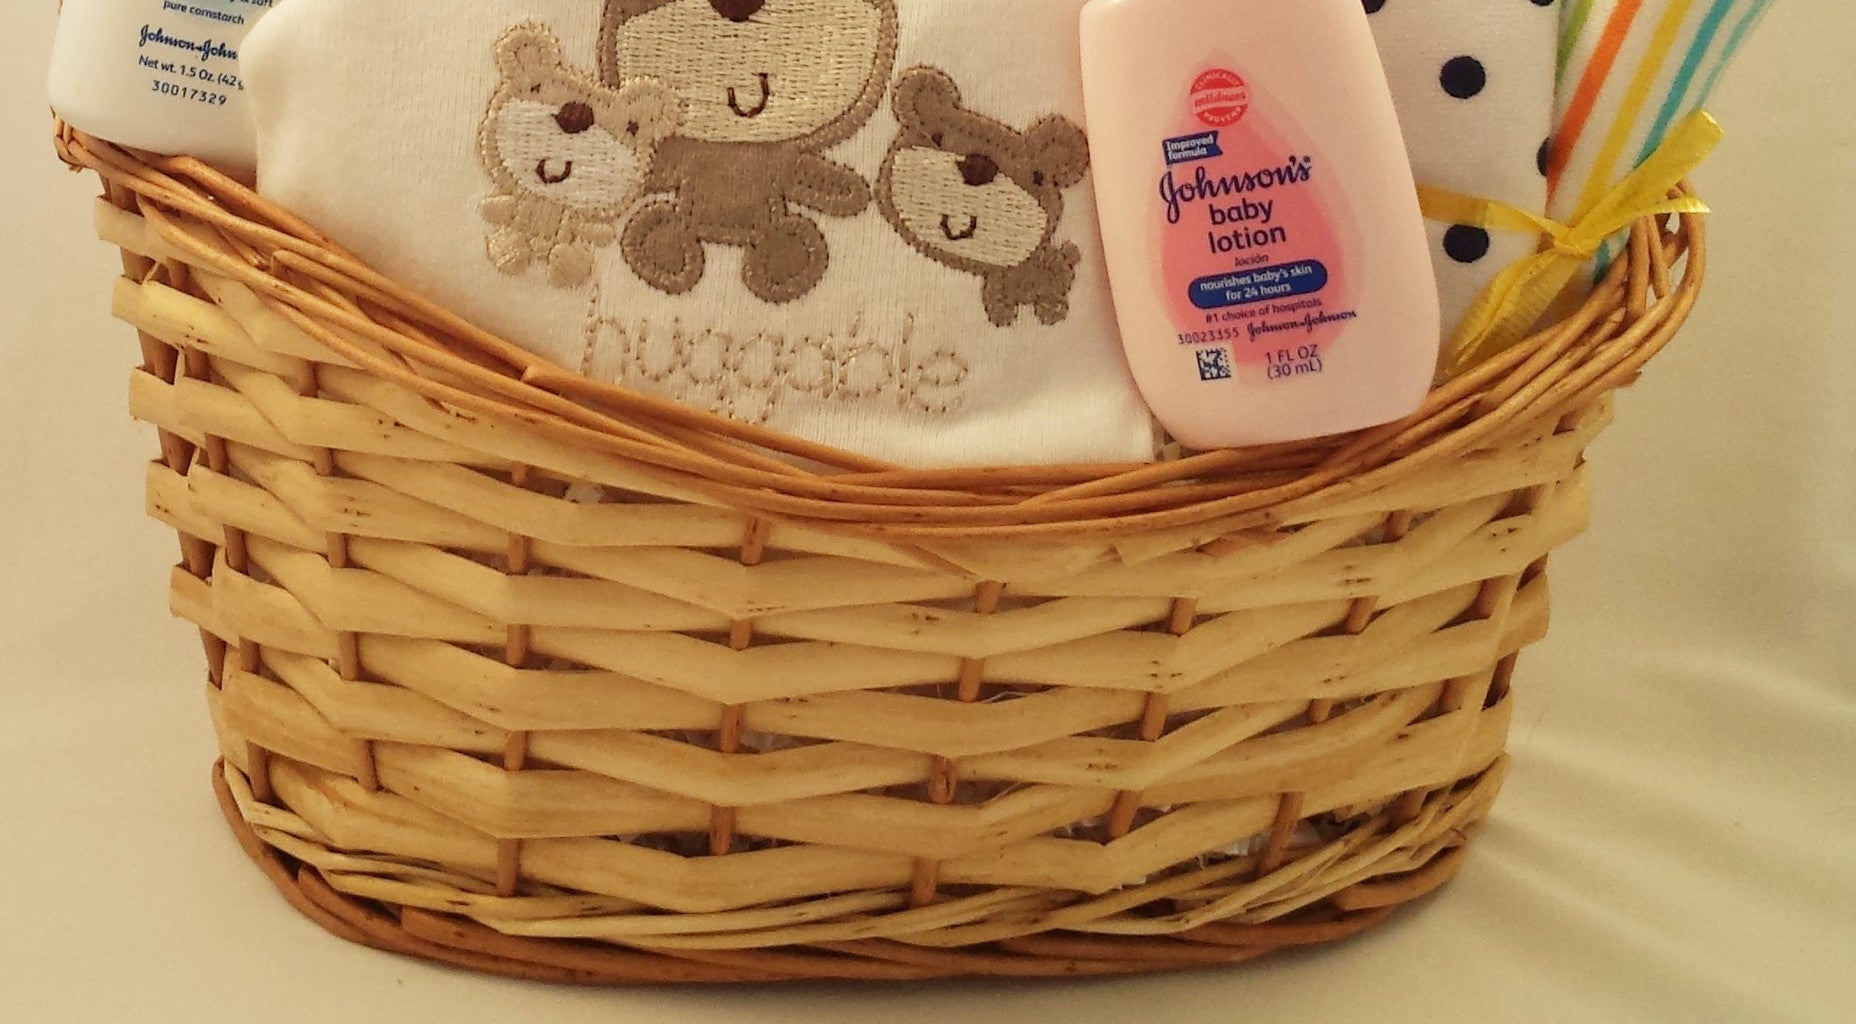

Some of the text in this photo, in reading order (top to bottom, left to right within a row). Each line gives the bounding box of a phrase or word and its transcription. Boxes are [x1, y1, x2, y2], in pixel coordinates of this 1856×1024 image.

[163, 0, 245, 25] pure cornstarch
[138, 54, 159, 70] Net
[180, 65, 197, 78] 1.5
[152, 79, 228, 106] 30017329
[1166, 134, 1214, 151] Improved
[1168, 146, 1208, 160] formula
[1159, 156, 1311, 224] Johnson's
[1208, 198, 1273, 226] baby
[1208, 227, 1287, 254] lotion
[1200, 264, 1313, 291] nourishes baby's skin
[1226, 282, 1292, 302] for 24 hours
[1205, 298, 1322, 323] #1 choice of hospitals
[1177, 327, 1240, 345] 30023355
[1265, 344, 1319, 365] 1 FL OZ
[1267, 359, 1323, 381] (30 mL)
